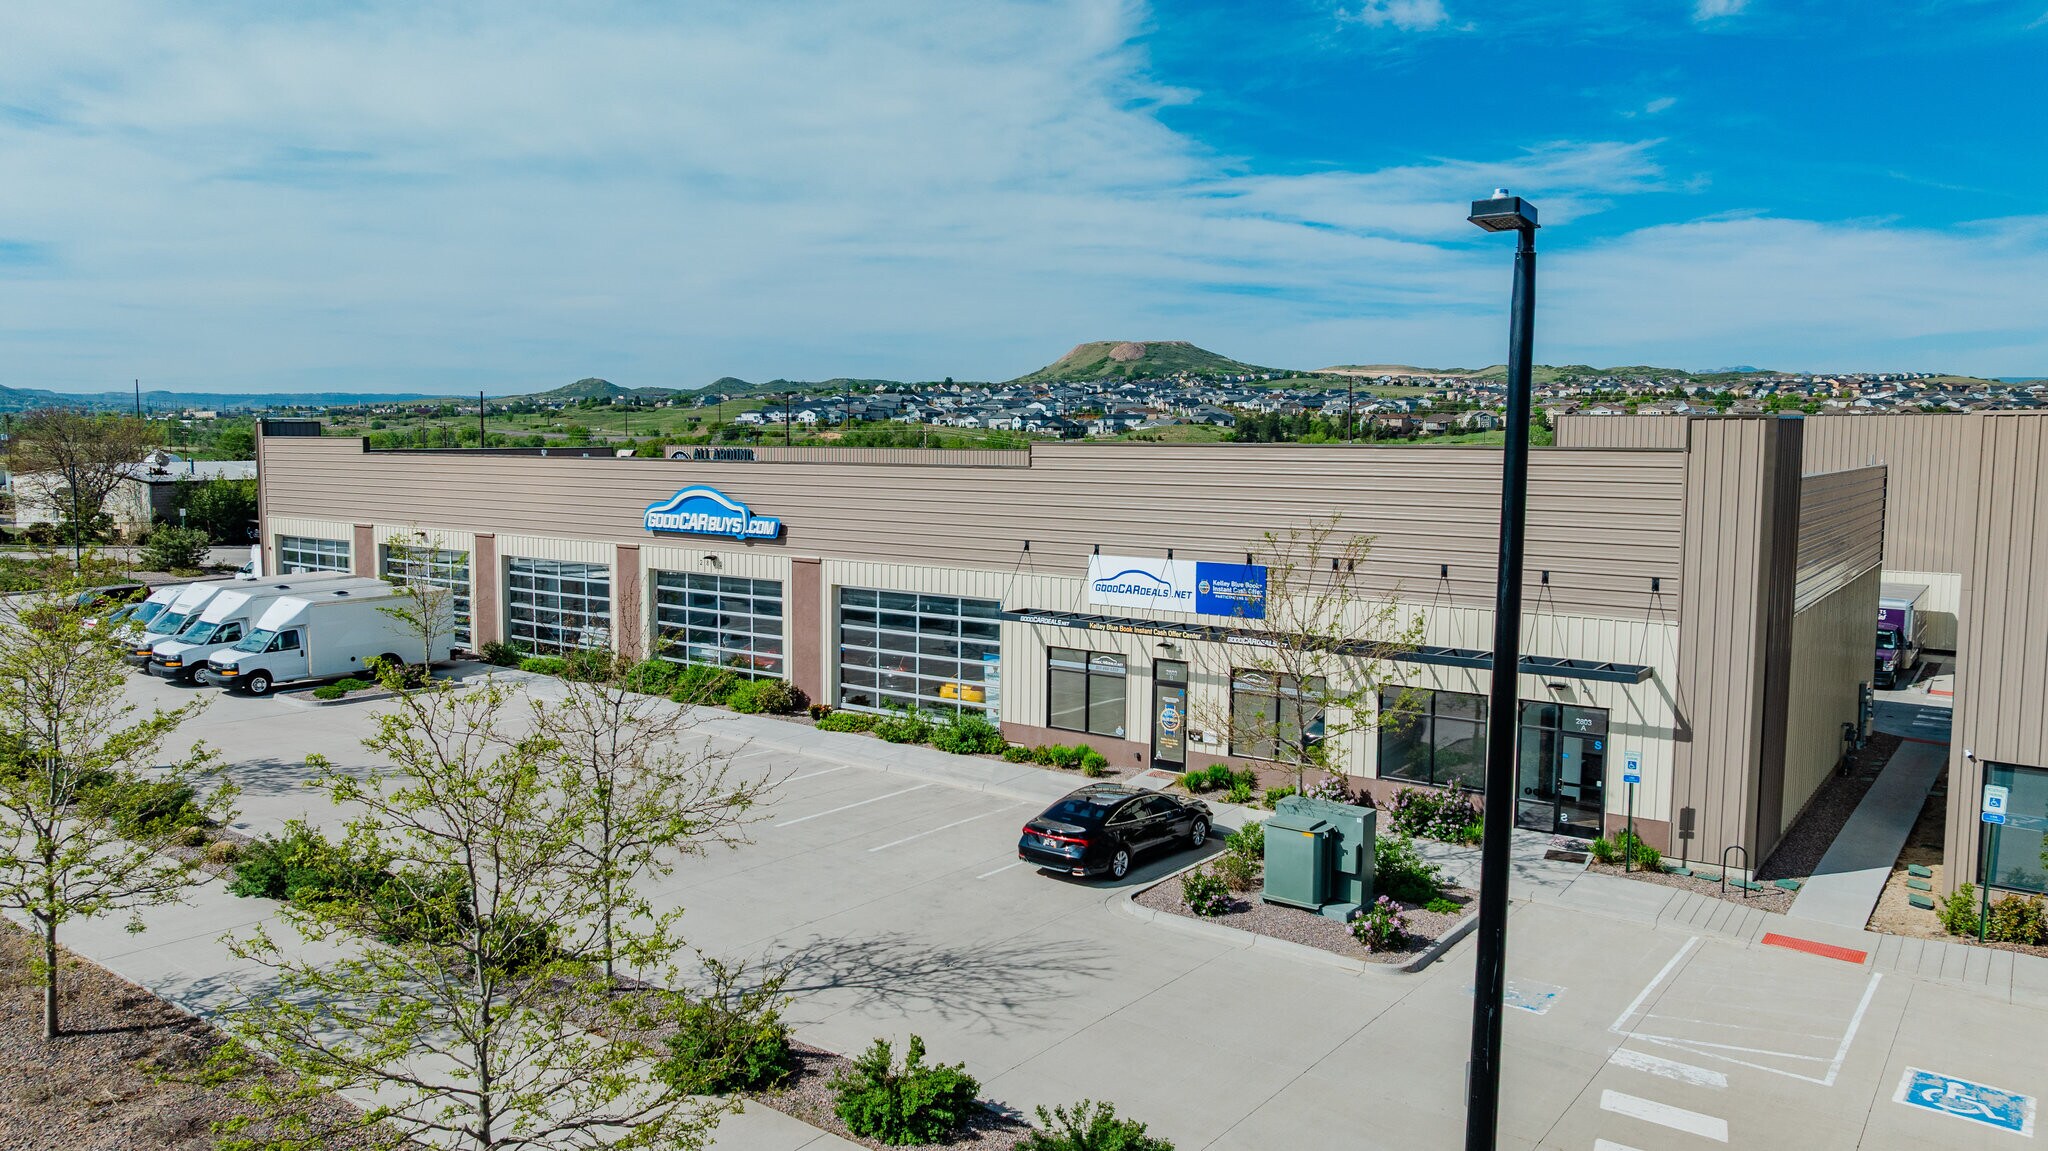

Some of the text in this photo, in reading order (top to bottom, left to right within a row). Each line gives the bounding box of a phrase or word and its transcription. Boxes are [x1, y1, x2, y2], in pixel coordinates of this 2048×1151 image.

[693, 447, 755, 461] ALL AROUND
[1212, 580, 1230, 588] Kelley
[1089, 622, 1202, 640] Kelley Blue Book Instant Cash Offer Center
[1575, 717, 1593, 726] 2803
